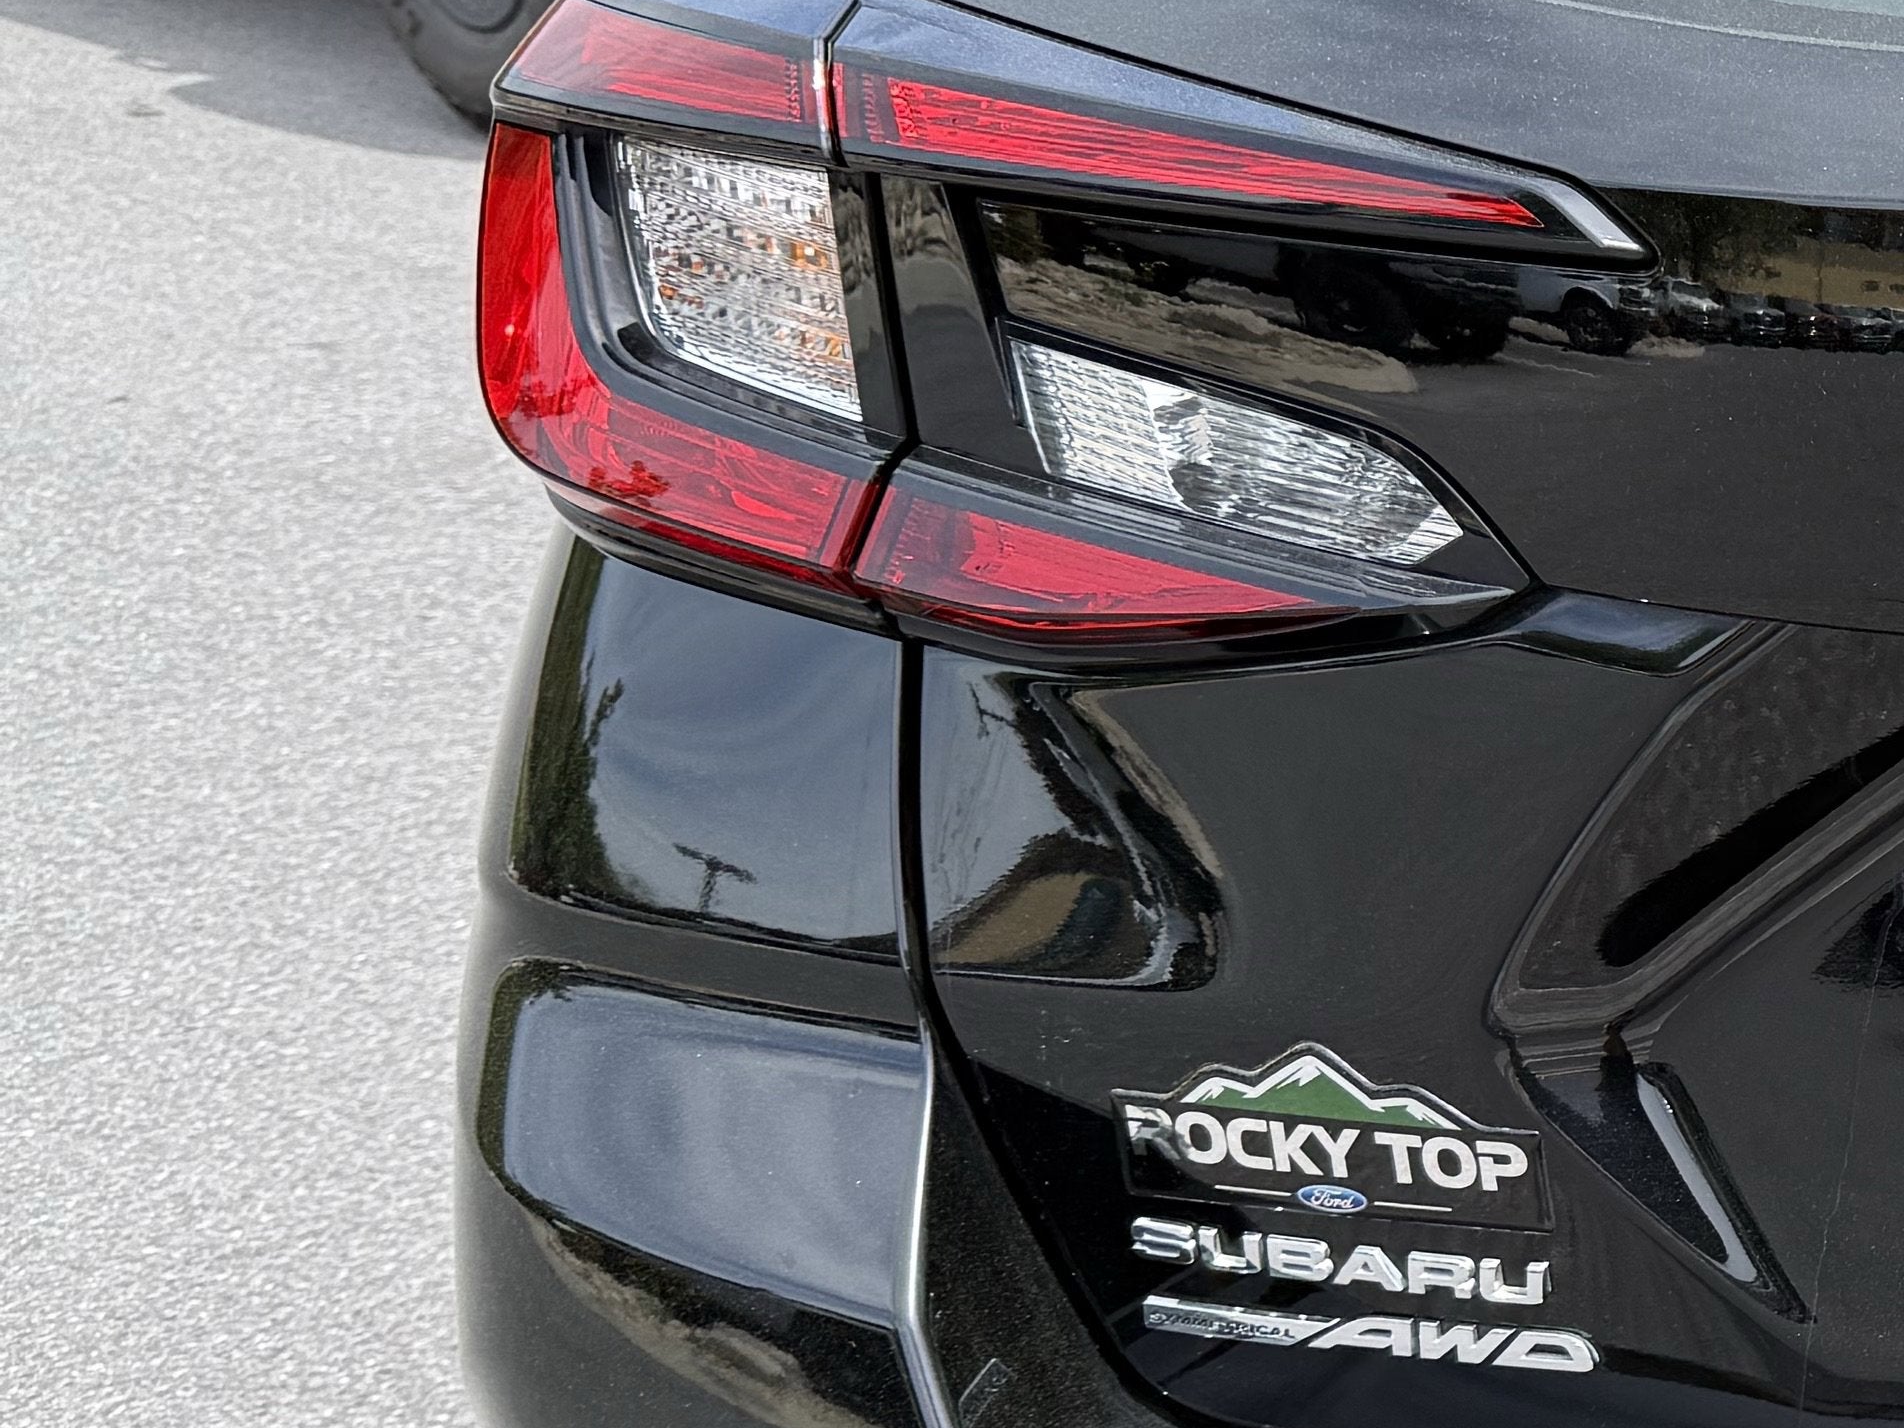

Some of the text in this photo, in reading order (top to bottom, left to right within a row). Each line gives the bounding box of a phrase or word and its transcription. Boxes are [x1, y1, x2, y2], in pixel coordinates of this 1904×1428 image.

[1125, 1103, 1529, 1192] ROCKY TOP
[1308, 1187, 1355, 1210] Ford
[1130, 1216, 1552, 1305] SUBARU
[1309, 1316, 1600, 1373] AWD
